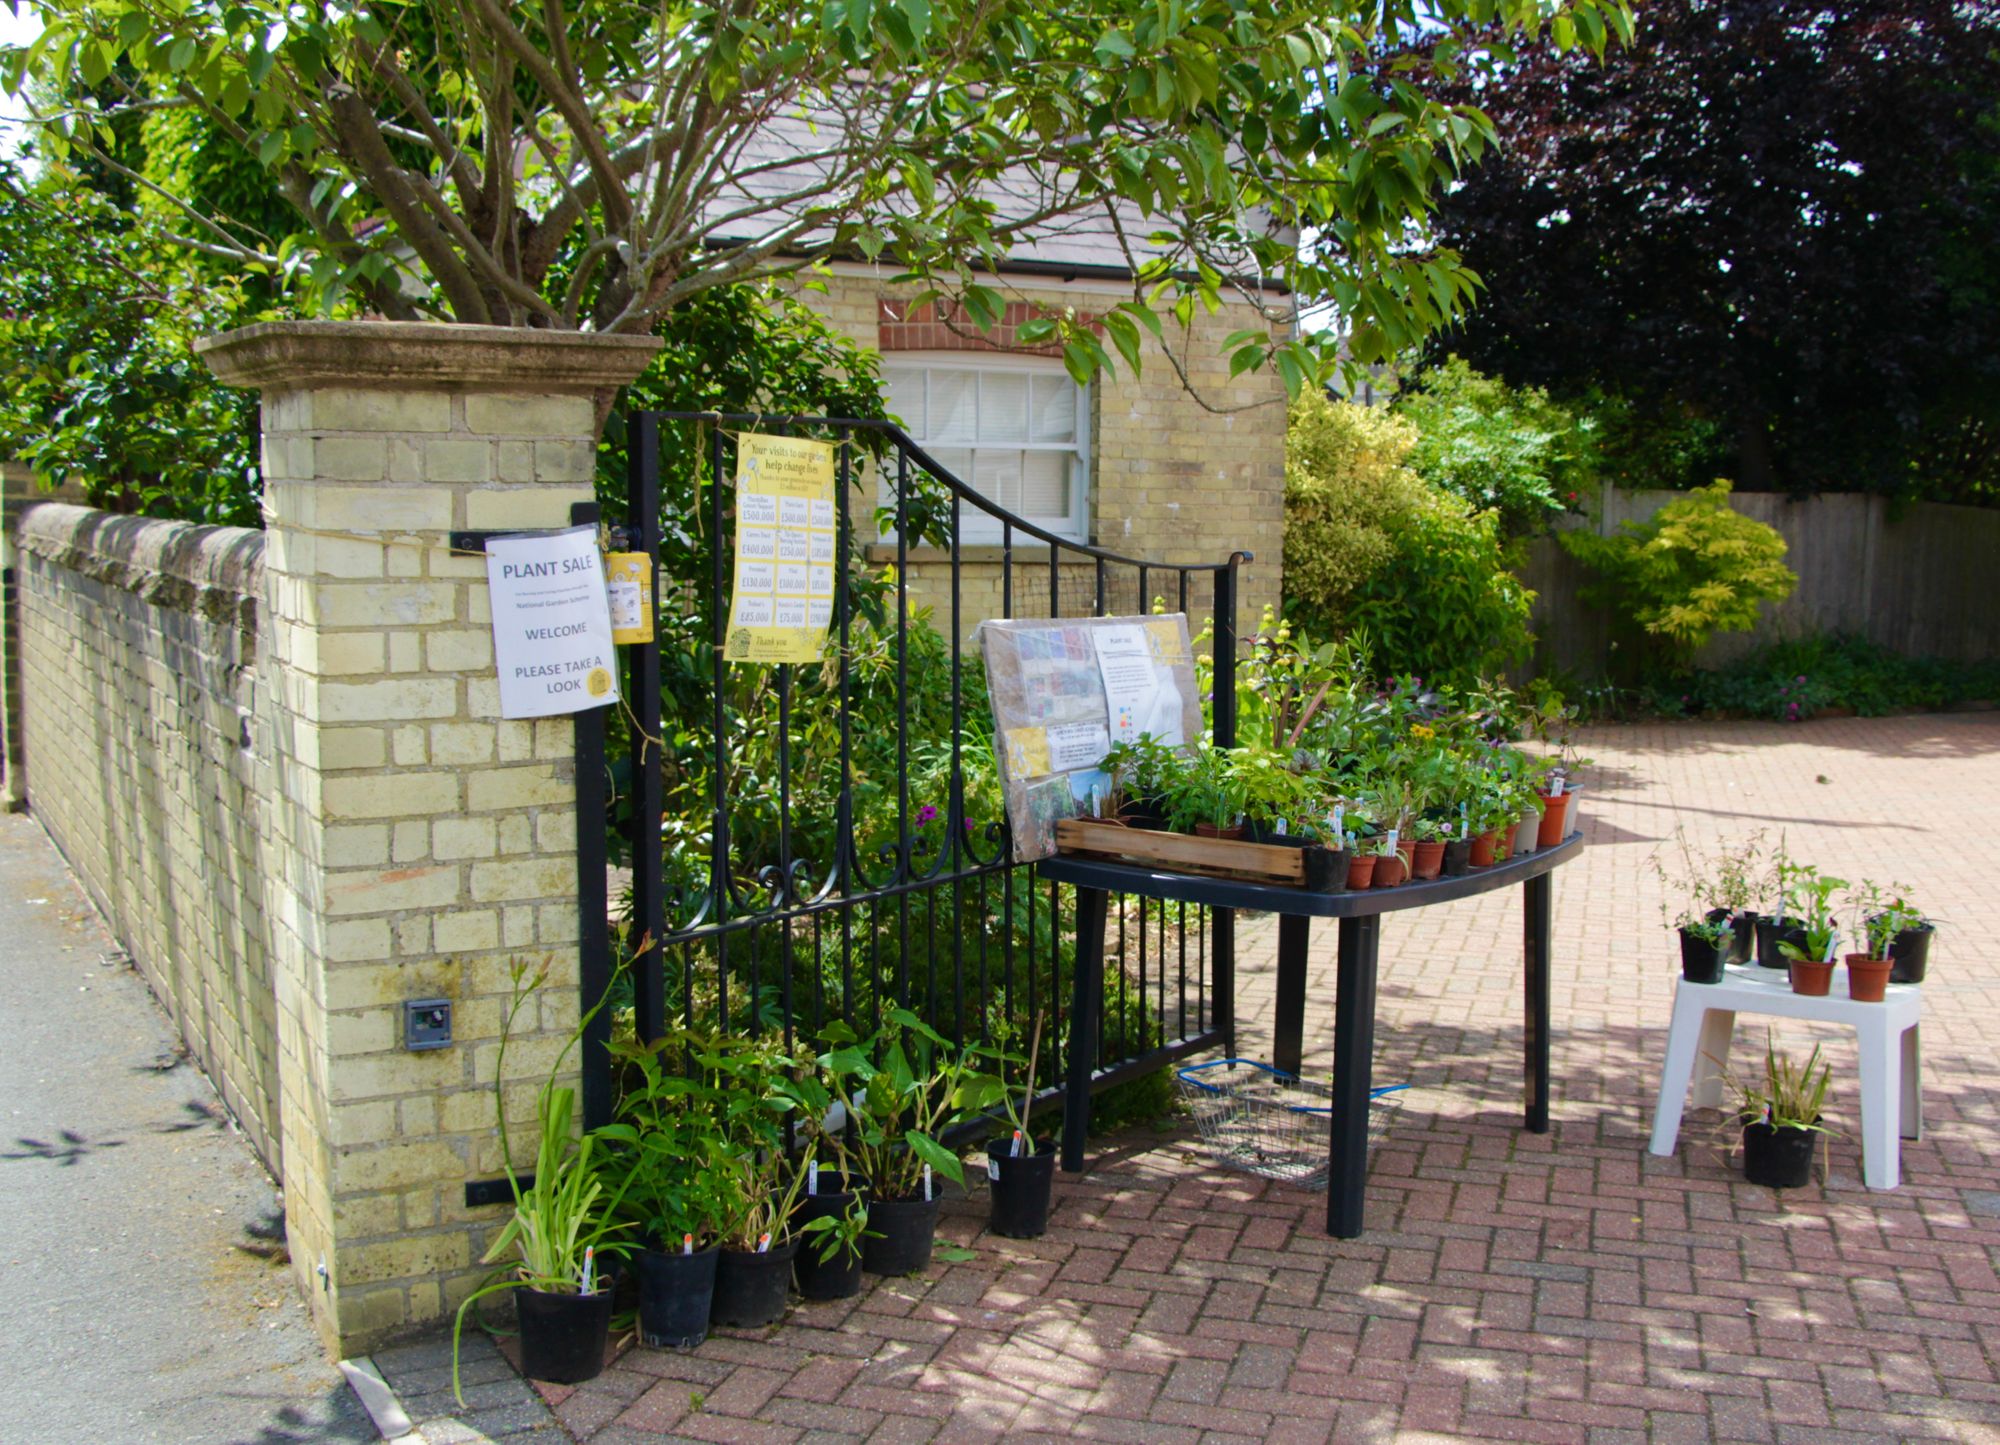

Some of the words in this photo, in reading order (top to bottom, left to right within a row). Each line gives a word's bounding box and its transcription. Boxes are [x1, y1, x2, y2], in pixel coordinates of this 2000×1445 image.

[751, 443, 768, 455] Your
[769, 446, 789, 457] visits
[790, 448, 797, 458] to
[765, 459, 783, 473] help
[783, 461, 806, 476] change
[743, 510, 775, 521] £500,000
[503, 561, 558, 579] PLANT
[562, 555, 593, 574] SALE
[516, 600, 544, 609] National
[545, 599, 569, 607] Garden
[569, 594, 590, 603] Scheme
[525, 622, 588, 640] WELCOME
[756, 636, 775, 646] Thank
[776, 639, 787, 649] you
[515, 663, 561, 678] PLEASE
[564, 658, 591, 673] TAKE
[594, 656, 603, 666] A
[547, 679, 581, 694] LOOK
